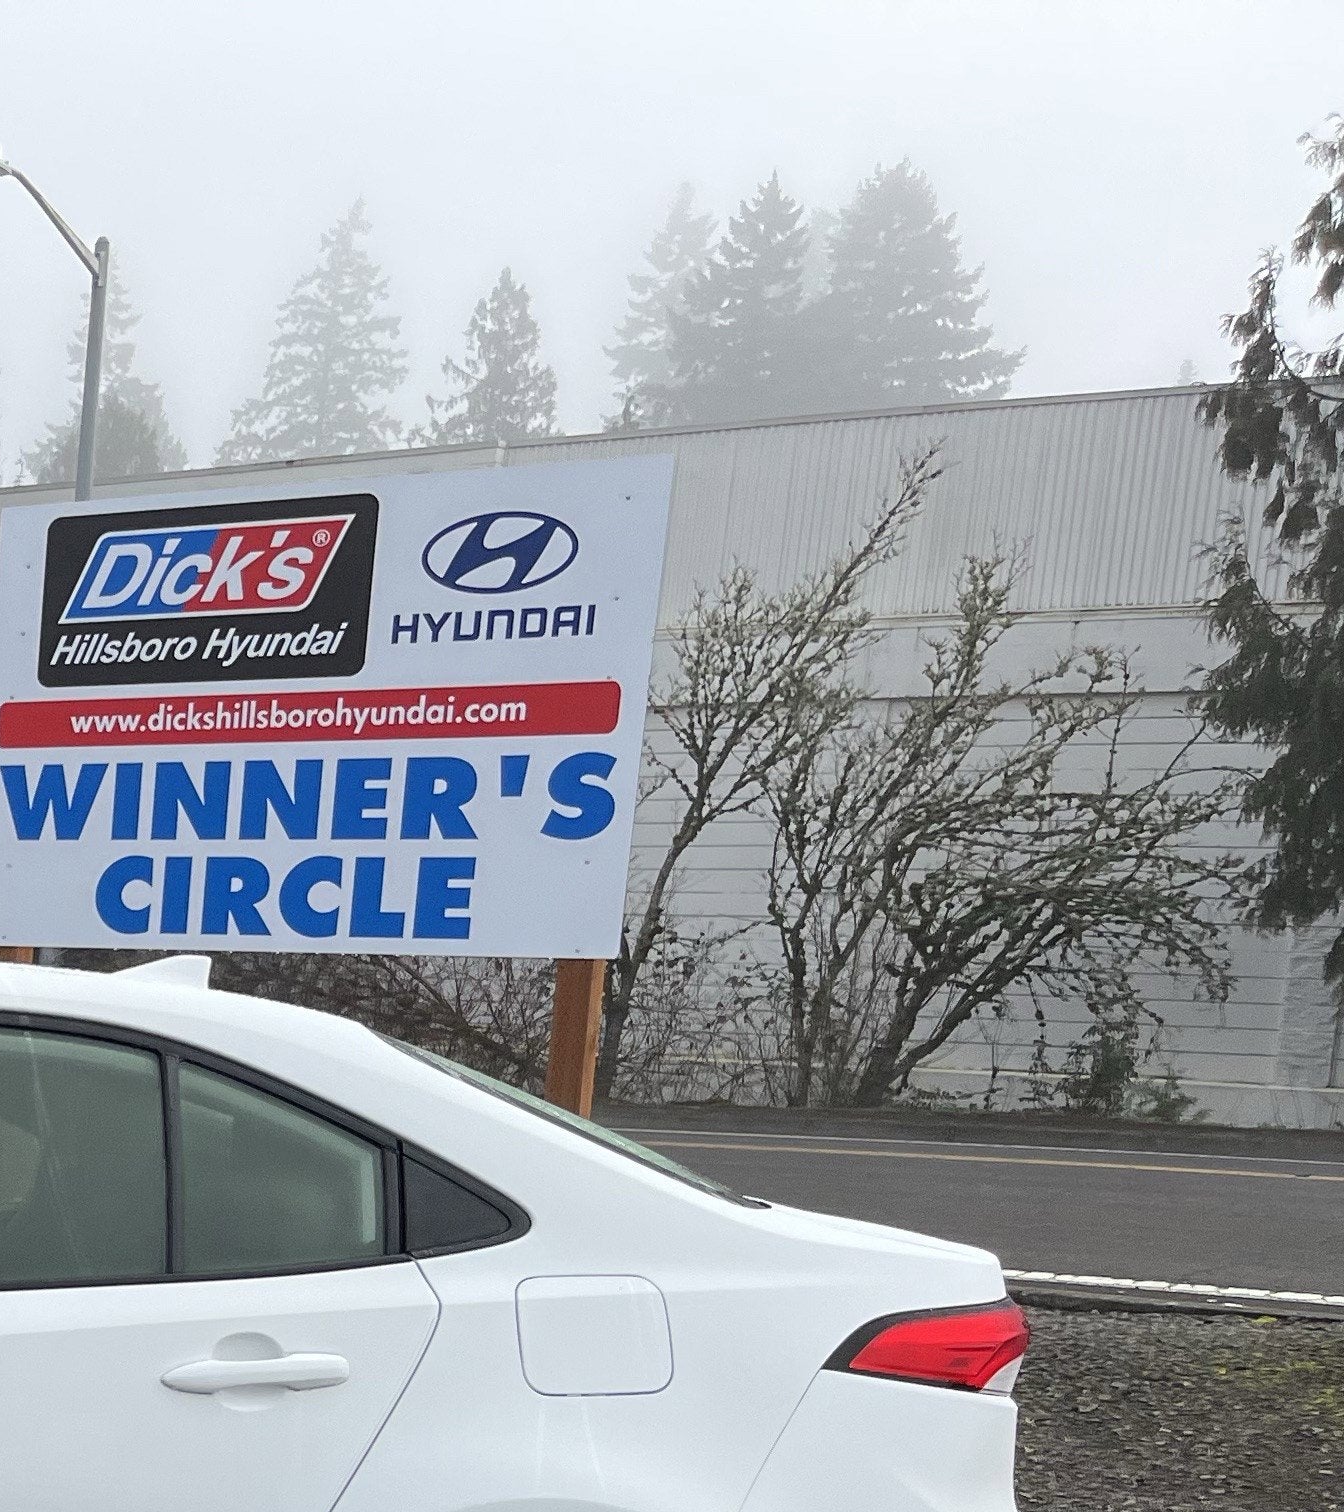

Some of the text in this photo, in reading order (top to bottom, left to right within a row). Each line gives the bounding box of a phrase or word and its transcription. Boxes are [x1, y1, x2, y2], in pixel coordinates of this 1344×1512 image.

[81, 531, 315, 609] Dick's
[50, 622, 348, 667] Hillsboro Hyundai
[391, 604, 596, 644] HYUNDAI
[70, 698, 528, 735] www.dickshillsborohyundai.com
[0, 751, 618, 841] WINNER'S
[94, 855, 476, 940] CIRCLE
